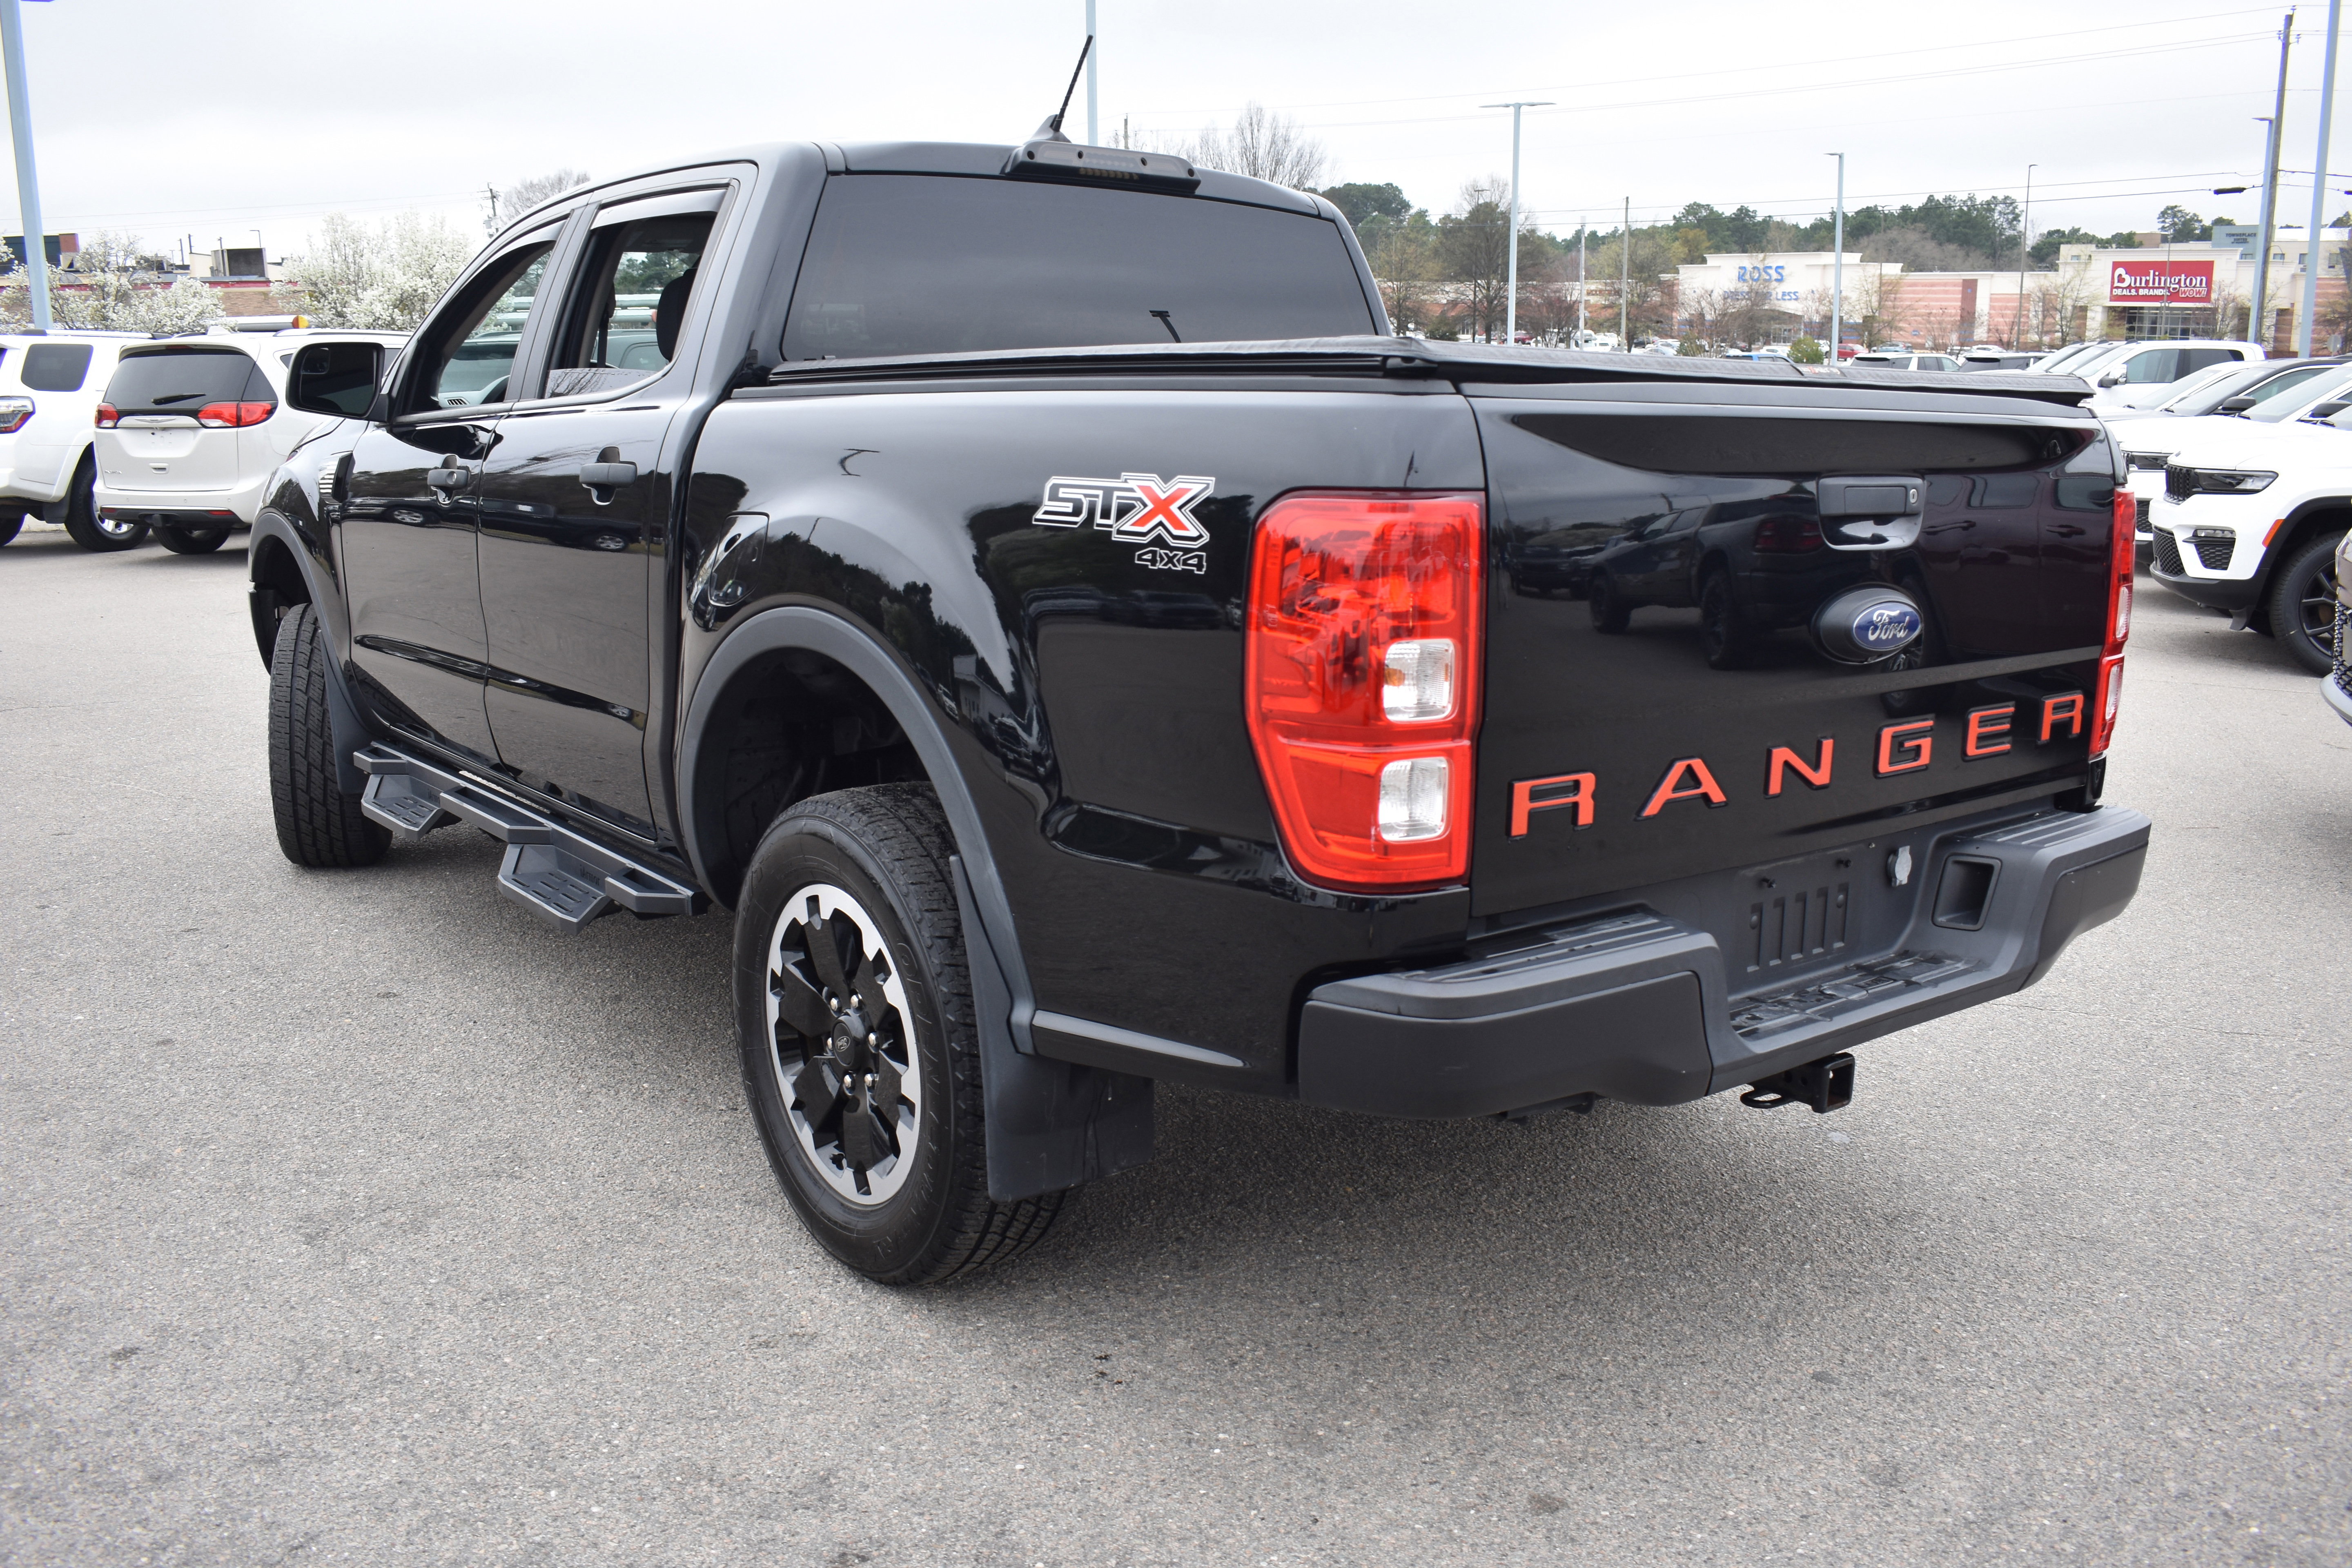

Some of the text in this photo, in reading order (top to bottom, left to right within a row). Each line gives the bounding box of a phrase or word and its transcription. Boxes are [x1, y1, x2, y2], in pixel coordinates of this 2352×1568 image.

[1738, 266, 1784, 282] ROSS
[2114, 267, 2207, 292] Burlington
[1776, 291, 1799, 301] LESS
[2179, 287, 2207, 297] WOW!
[1032, 472, 1216, 548] STX
[1868, 610, 1910, 641] Ford
[1508, 690, 2084, 840] RANGER
